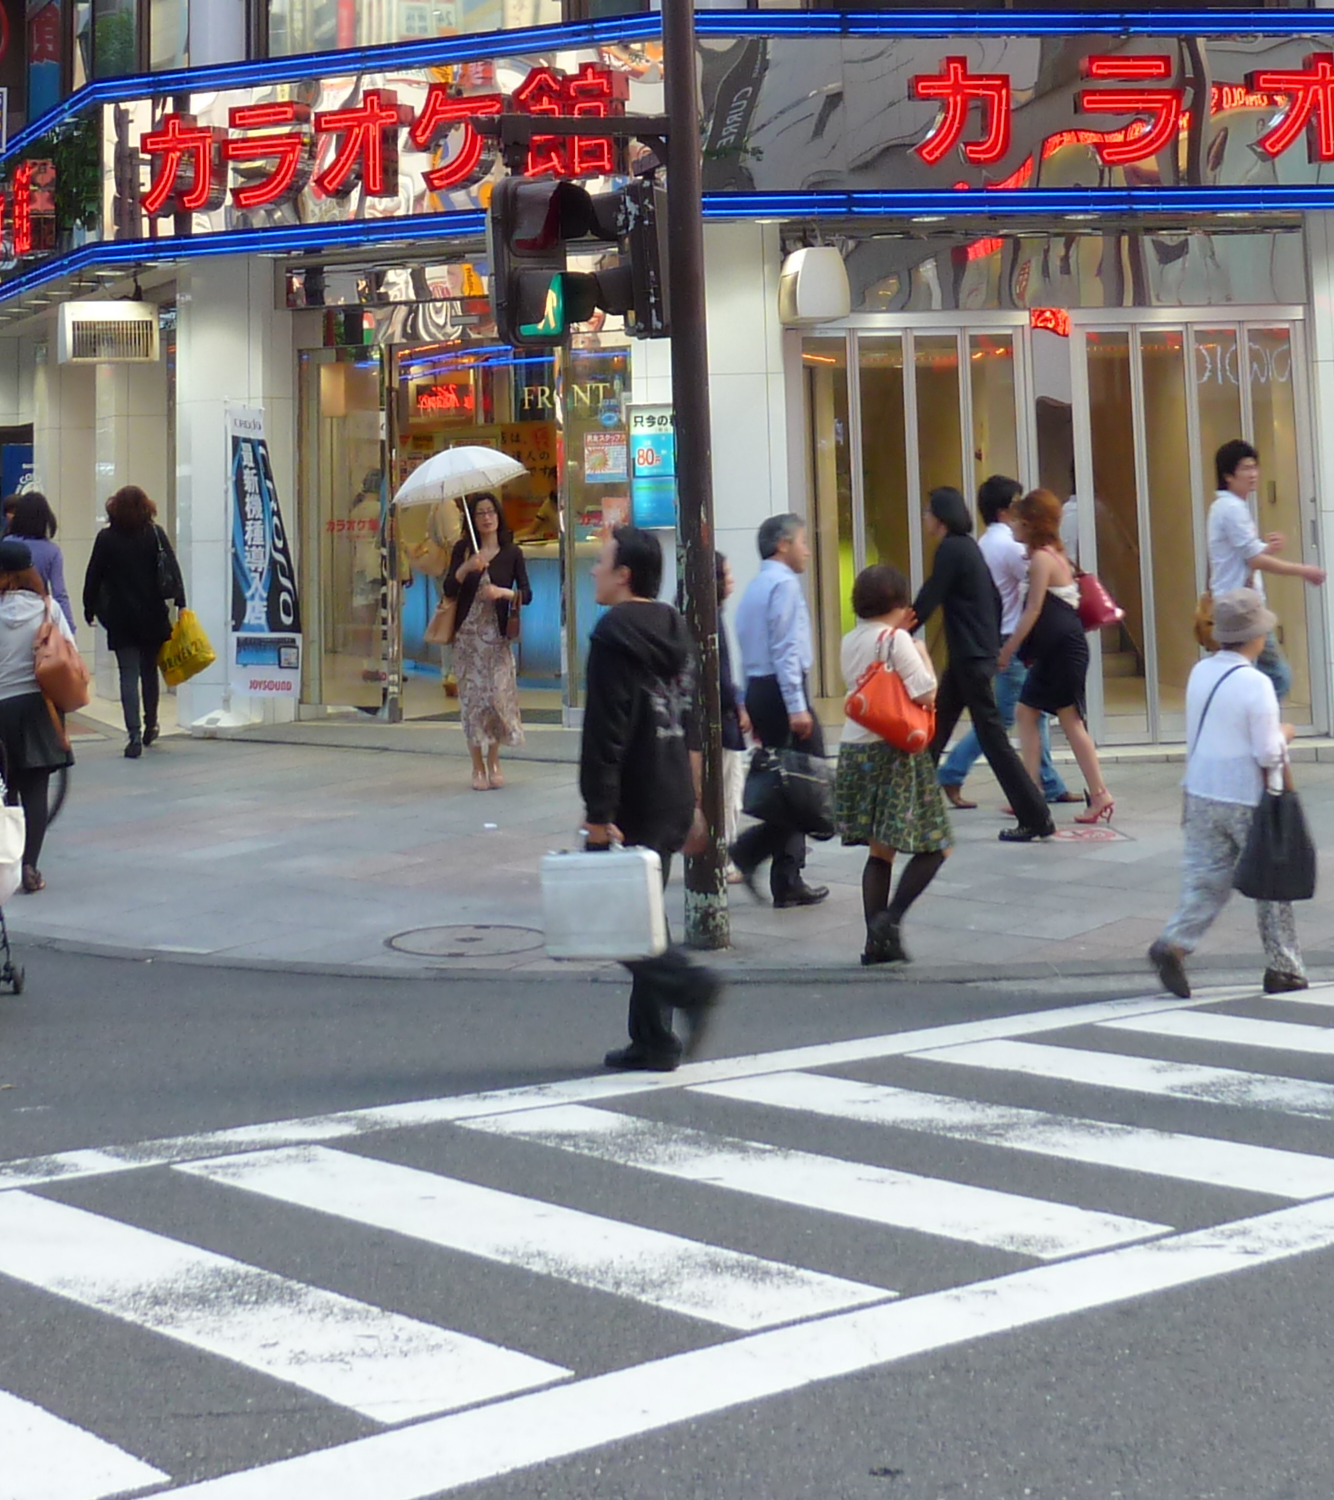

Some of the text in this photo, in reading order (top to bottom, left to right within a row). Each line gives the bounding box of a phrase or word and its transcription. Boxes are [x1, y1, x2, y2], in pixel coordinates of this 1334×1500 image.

[140, 64, 617, 215] カラオケ館
[523, 382, 610, 410] FRNT
[240, 442, 269, 625] 最新機種導入店
[249, 678, 293, 692] JOYSOUND
